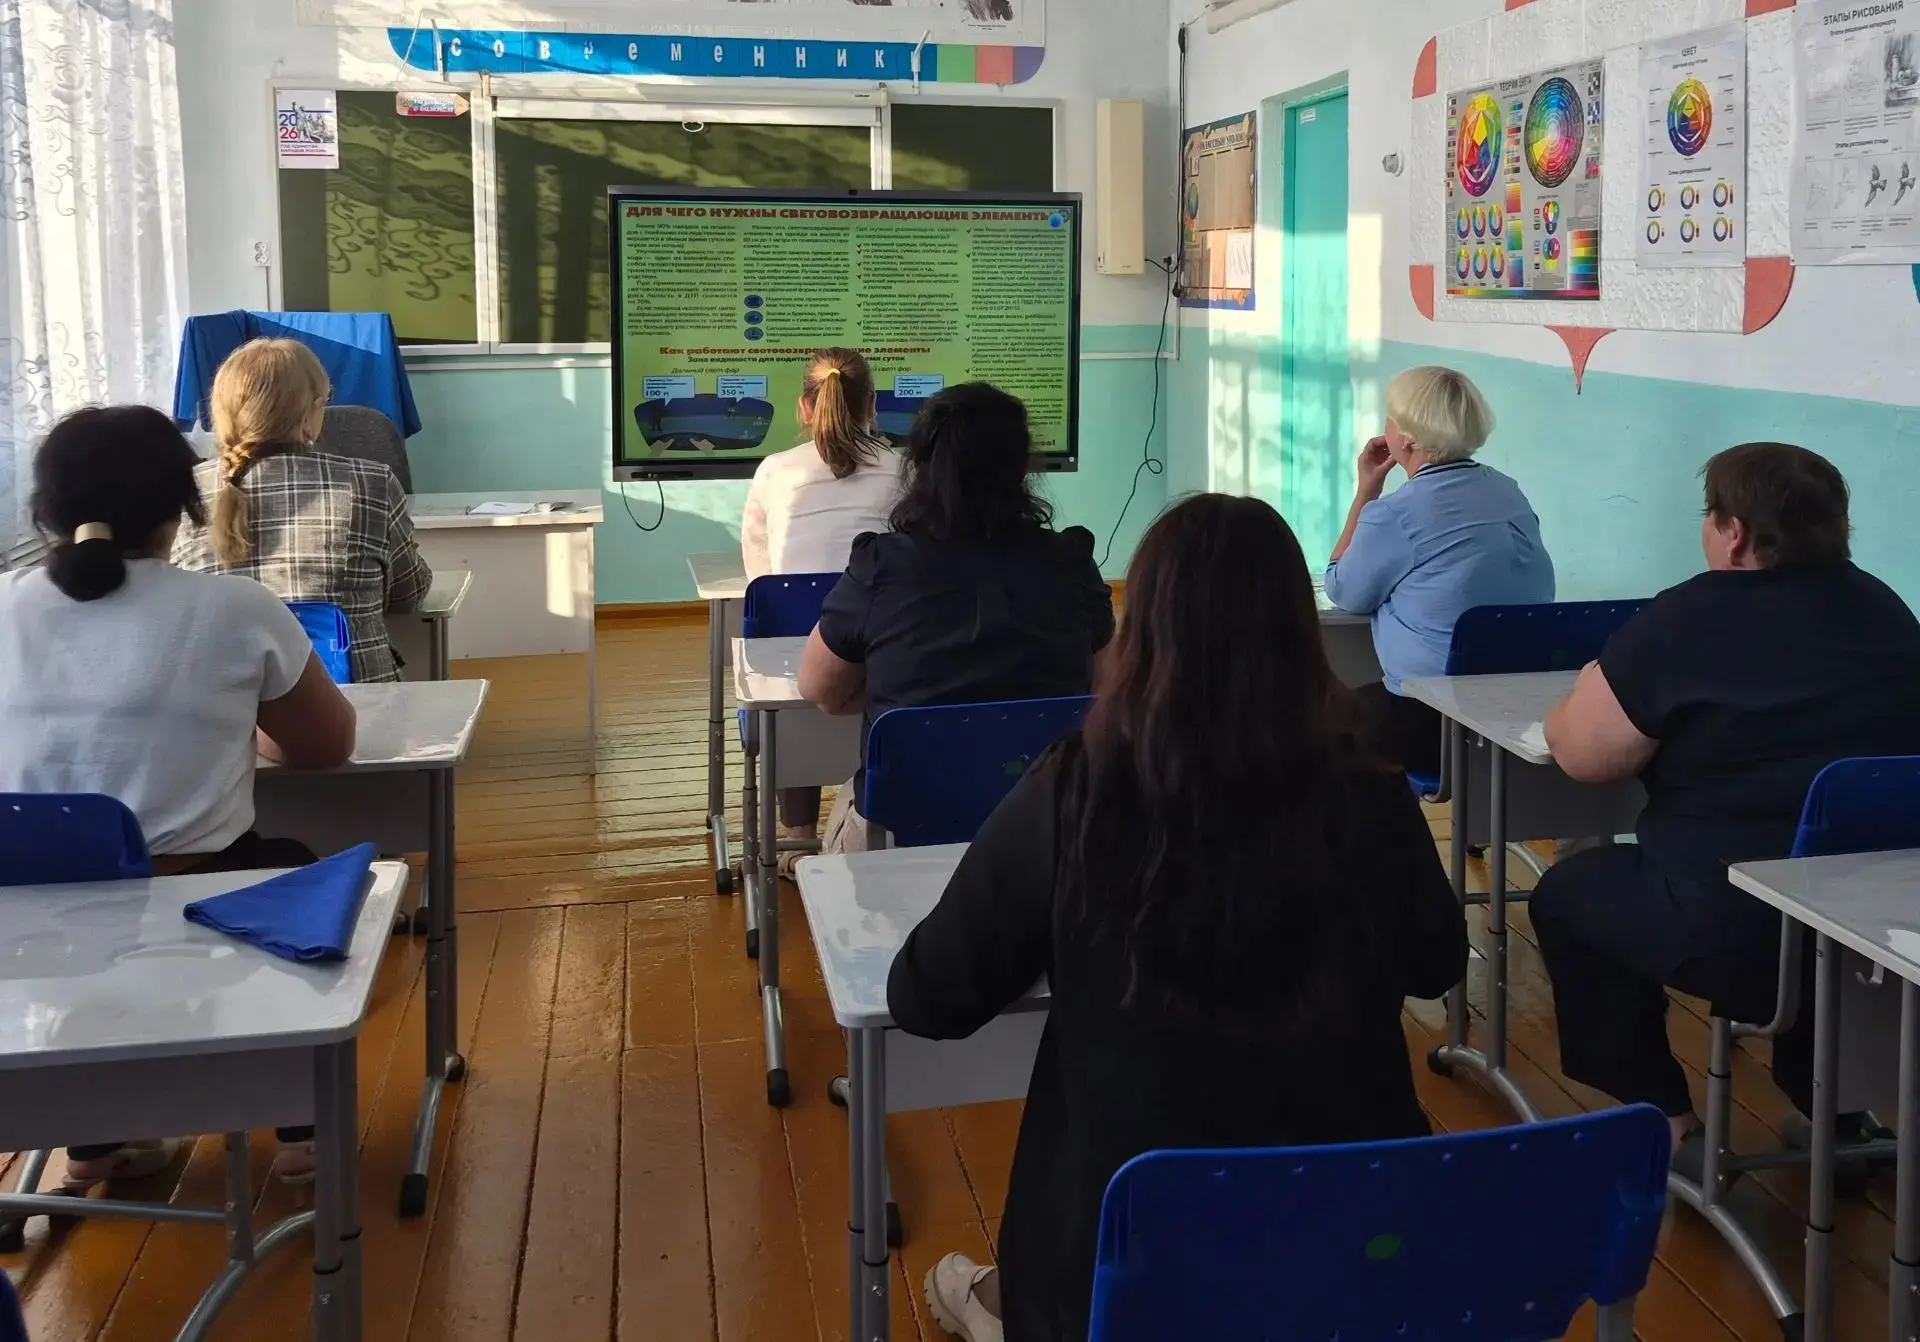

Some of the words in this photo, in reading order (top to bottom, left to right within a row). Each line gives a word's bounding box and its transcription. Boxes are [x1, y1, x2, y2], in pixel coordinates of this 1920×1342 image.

[1823, 11, 1851, 26] ЭТАПЫ
[1852, 1, 1904, 20] РИСОВАНИЯ
[279, 113, 298, 127] 20
[280, 127, 298, 140] 26
[626, 206, 663, 218] ДЛЯ
[665, 207, 707, 217] ЧЕГО
[709, 207, 777, 218] НУЖНЫ
[779, 209, 969, 222] СВЕТОВОЗВРАЩАЮЩИЕ
[659, 346, 683, 355] Как
[686, 346, 746, 357] работают
[758, 356, 775, 364] для
[882, 356, 905, 364] суток
[724, 367, 740, 375] фар
[645, 389, 661, 397] 100
[720, 388, 737, 396] 350
